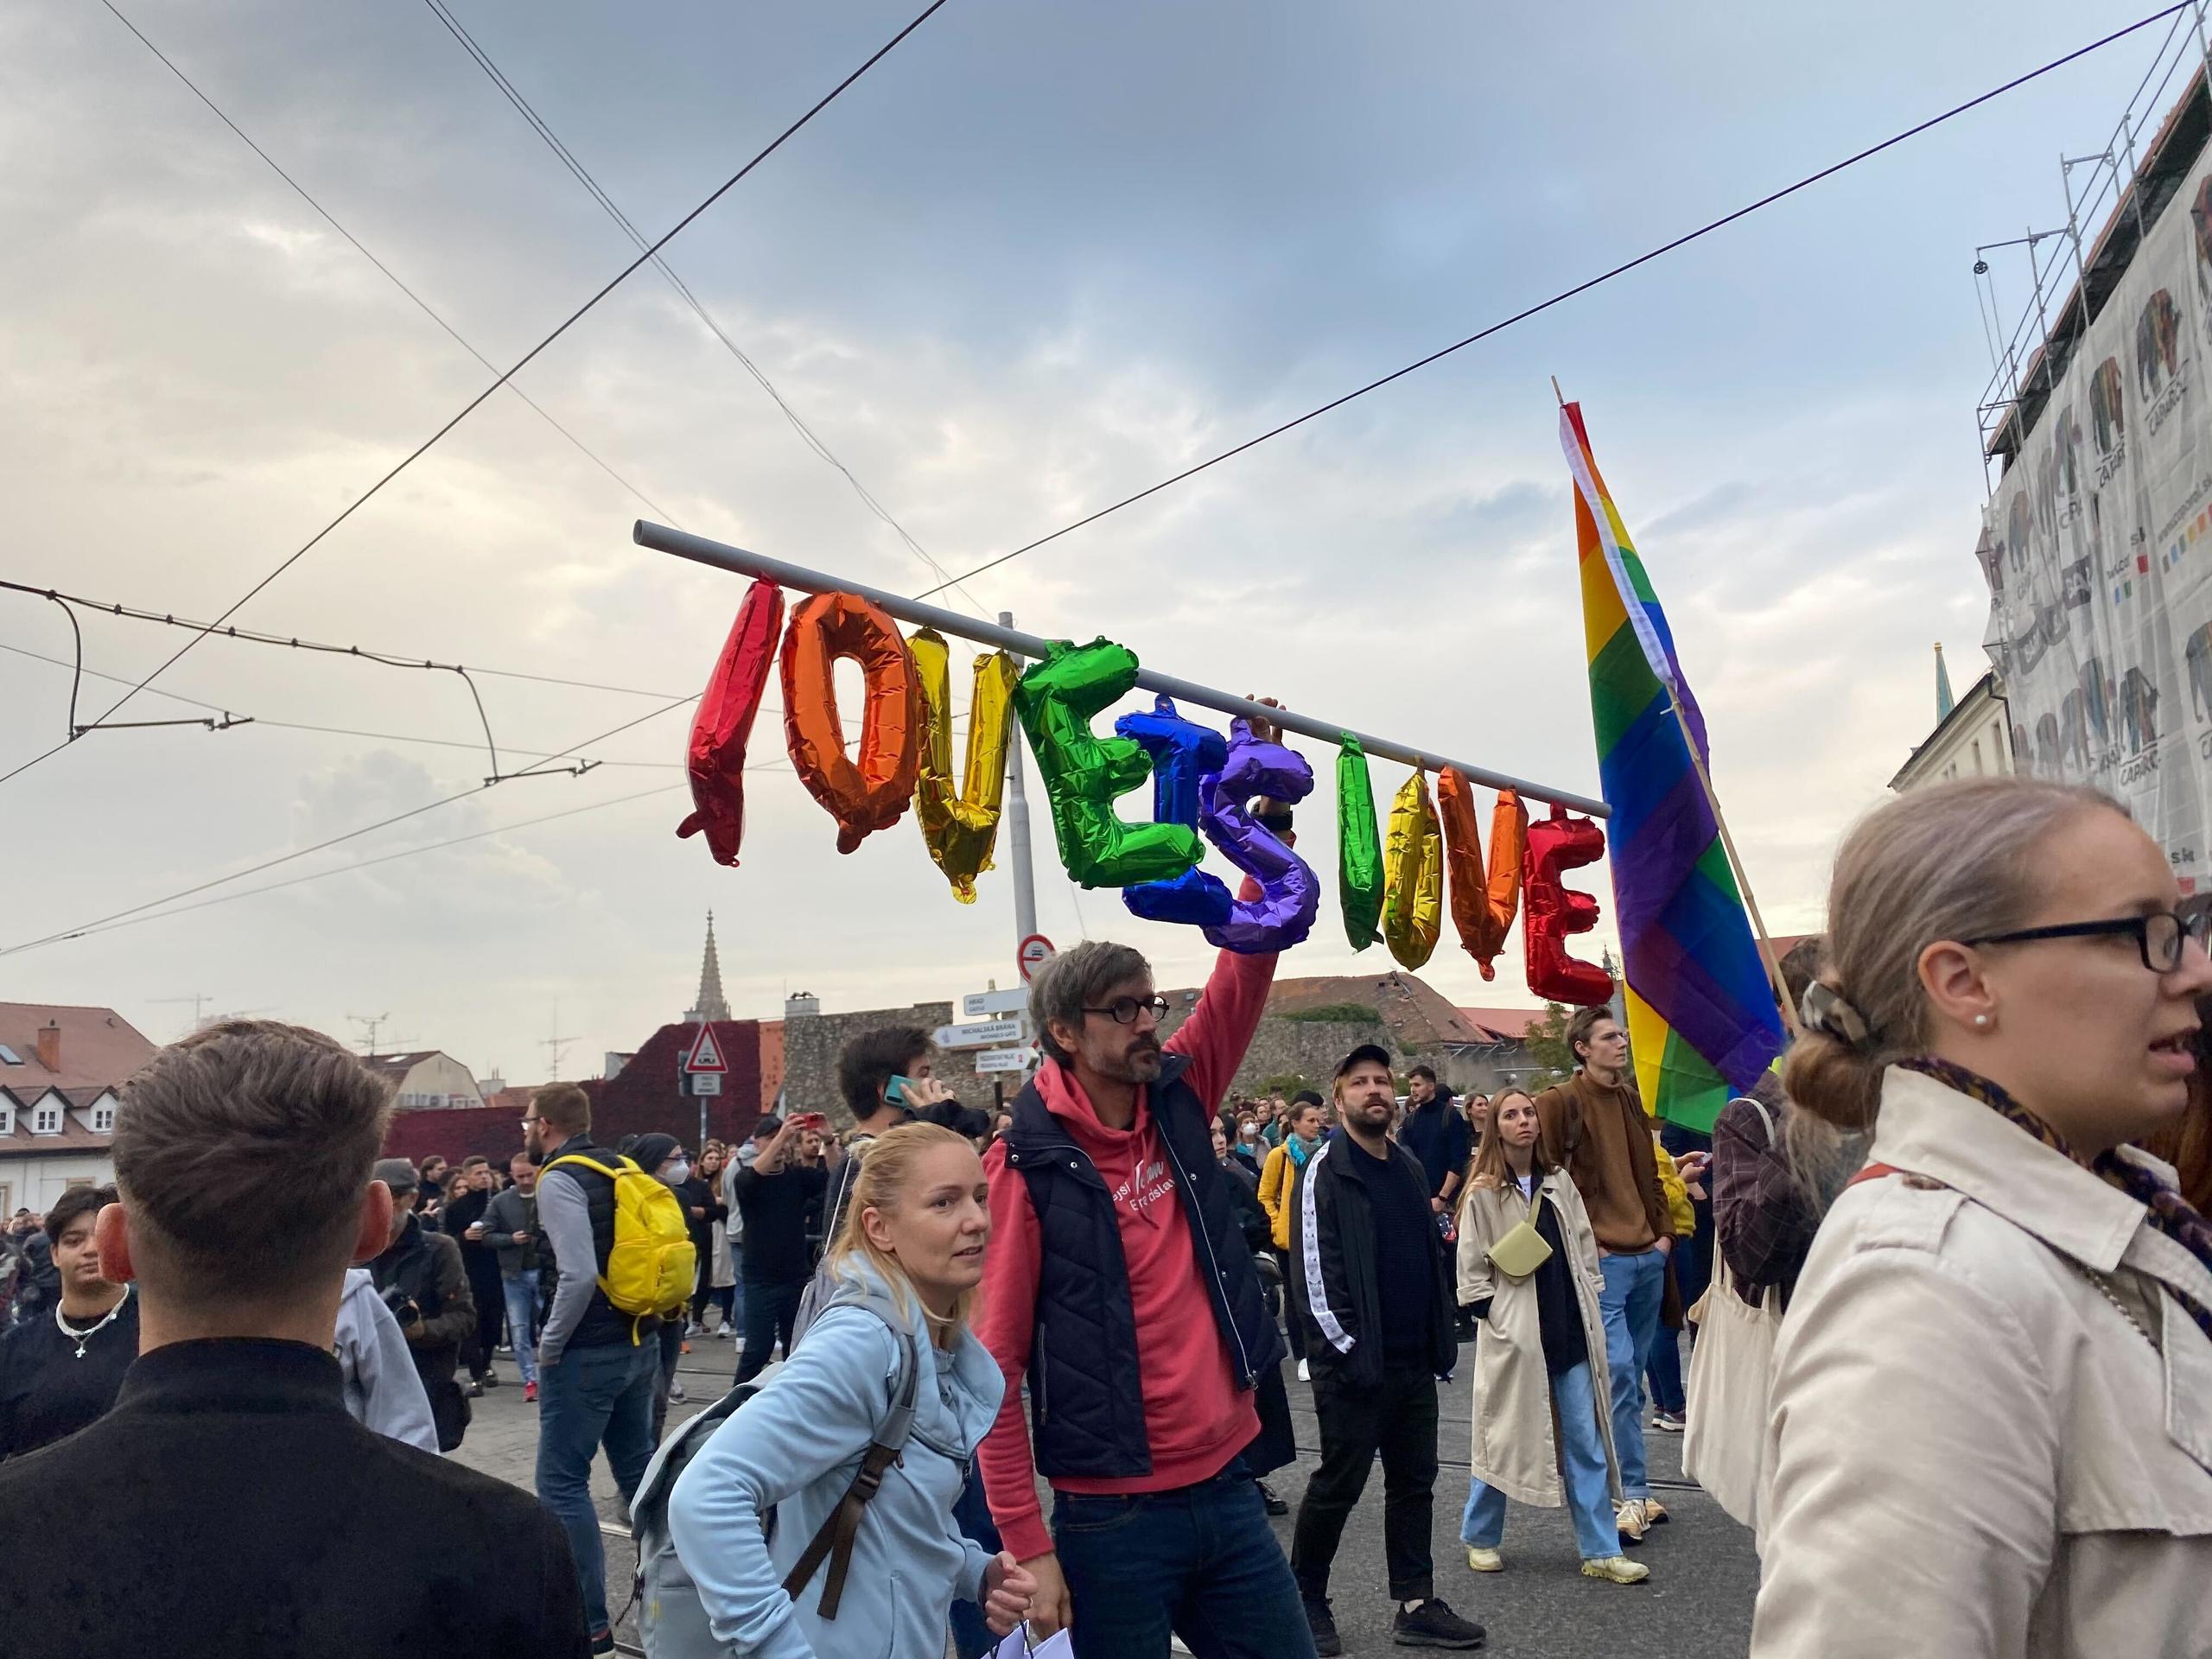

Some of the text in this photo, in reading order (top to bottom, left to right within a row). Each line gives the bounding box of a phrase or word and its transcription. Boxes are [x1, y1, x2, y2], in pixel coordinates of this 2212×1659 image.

[676, 574, 1614, 1007] LOVE IS LOVE
